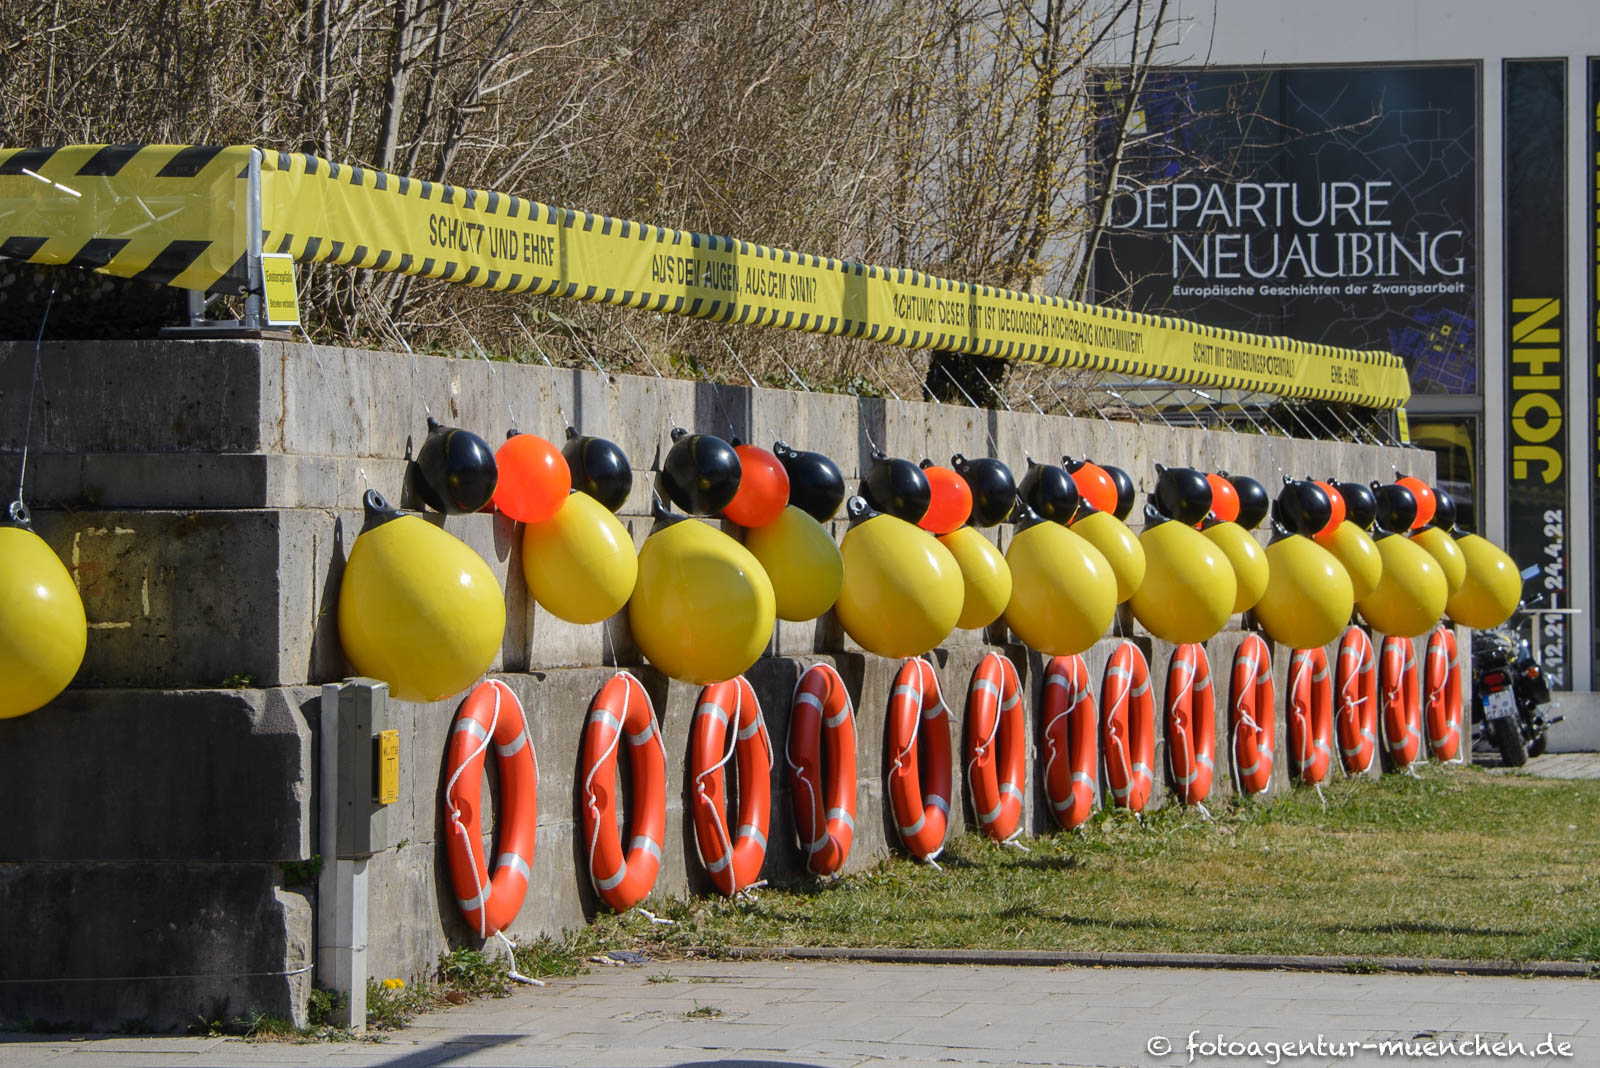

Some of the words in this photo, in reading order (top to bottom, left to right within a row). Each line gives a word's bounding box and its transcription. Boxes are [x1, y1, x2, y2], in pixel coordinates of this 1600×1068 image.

[1107, 182, 1392, 228] DEPARTURE
[489, 226, 518, 261] UND
[523, 232, 555, 267] EHRE
[1172, 230, 1465, 279] NEUAUBING
[652, 253, 675, 284] AUS
[745, 267, 767, 297] AUS
[1173, 285, 1255, 298] Europäische
[1259, 283, 1341, 296] Geschichten
[1344, 283, 1368, 295] der
[1372, 281, 1465, 297] Zwangsarbeit
[893, 293, 937, 323] ACHTUNG!
[984, 305, 996, 330] IST
[1512, 298, 1563, 485] JOHN
